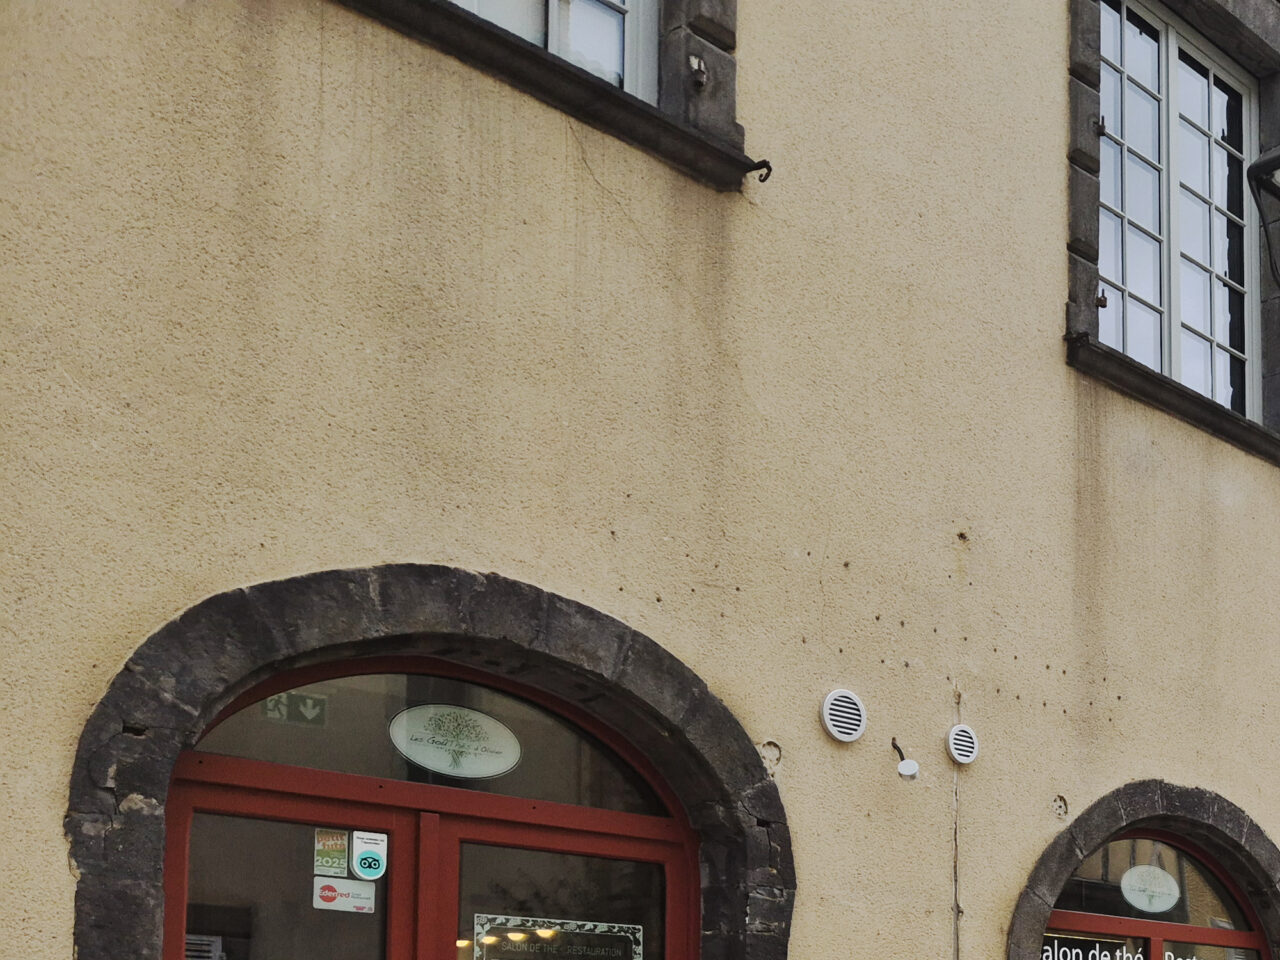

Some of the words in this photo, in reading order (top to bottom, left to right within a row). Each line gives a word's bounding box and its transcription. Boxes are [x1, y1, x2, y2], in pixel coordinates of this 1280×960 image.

[316, 857, 346, 868] 2025
[501, 941, 528, 952] SALON
[529, 943, 541, 953] DE
[567, 945, 622, 957] RESTAURATION
